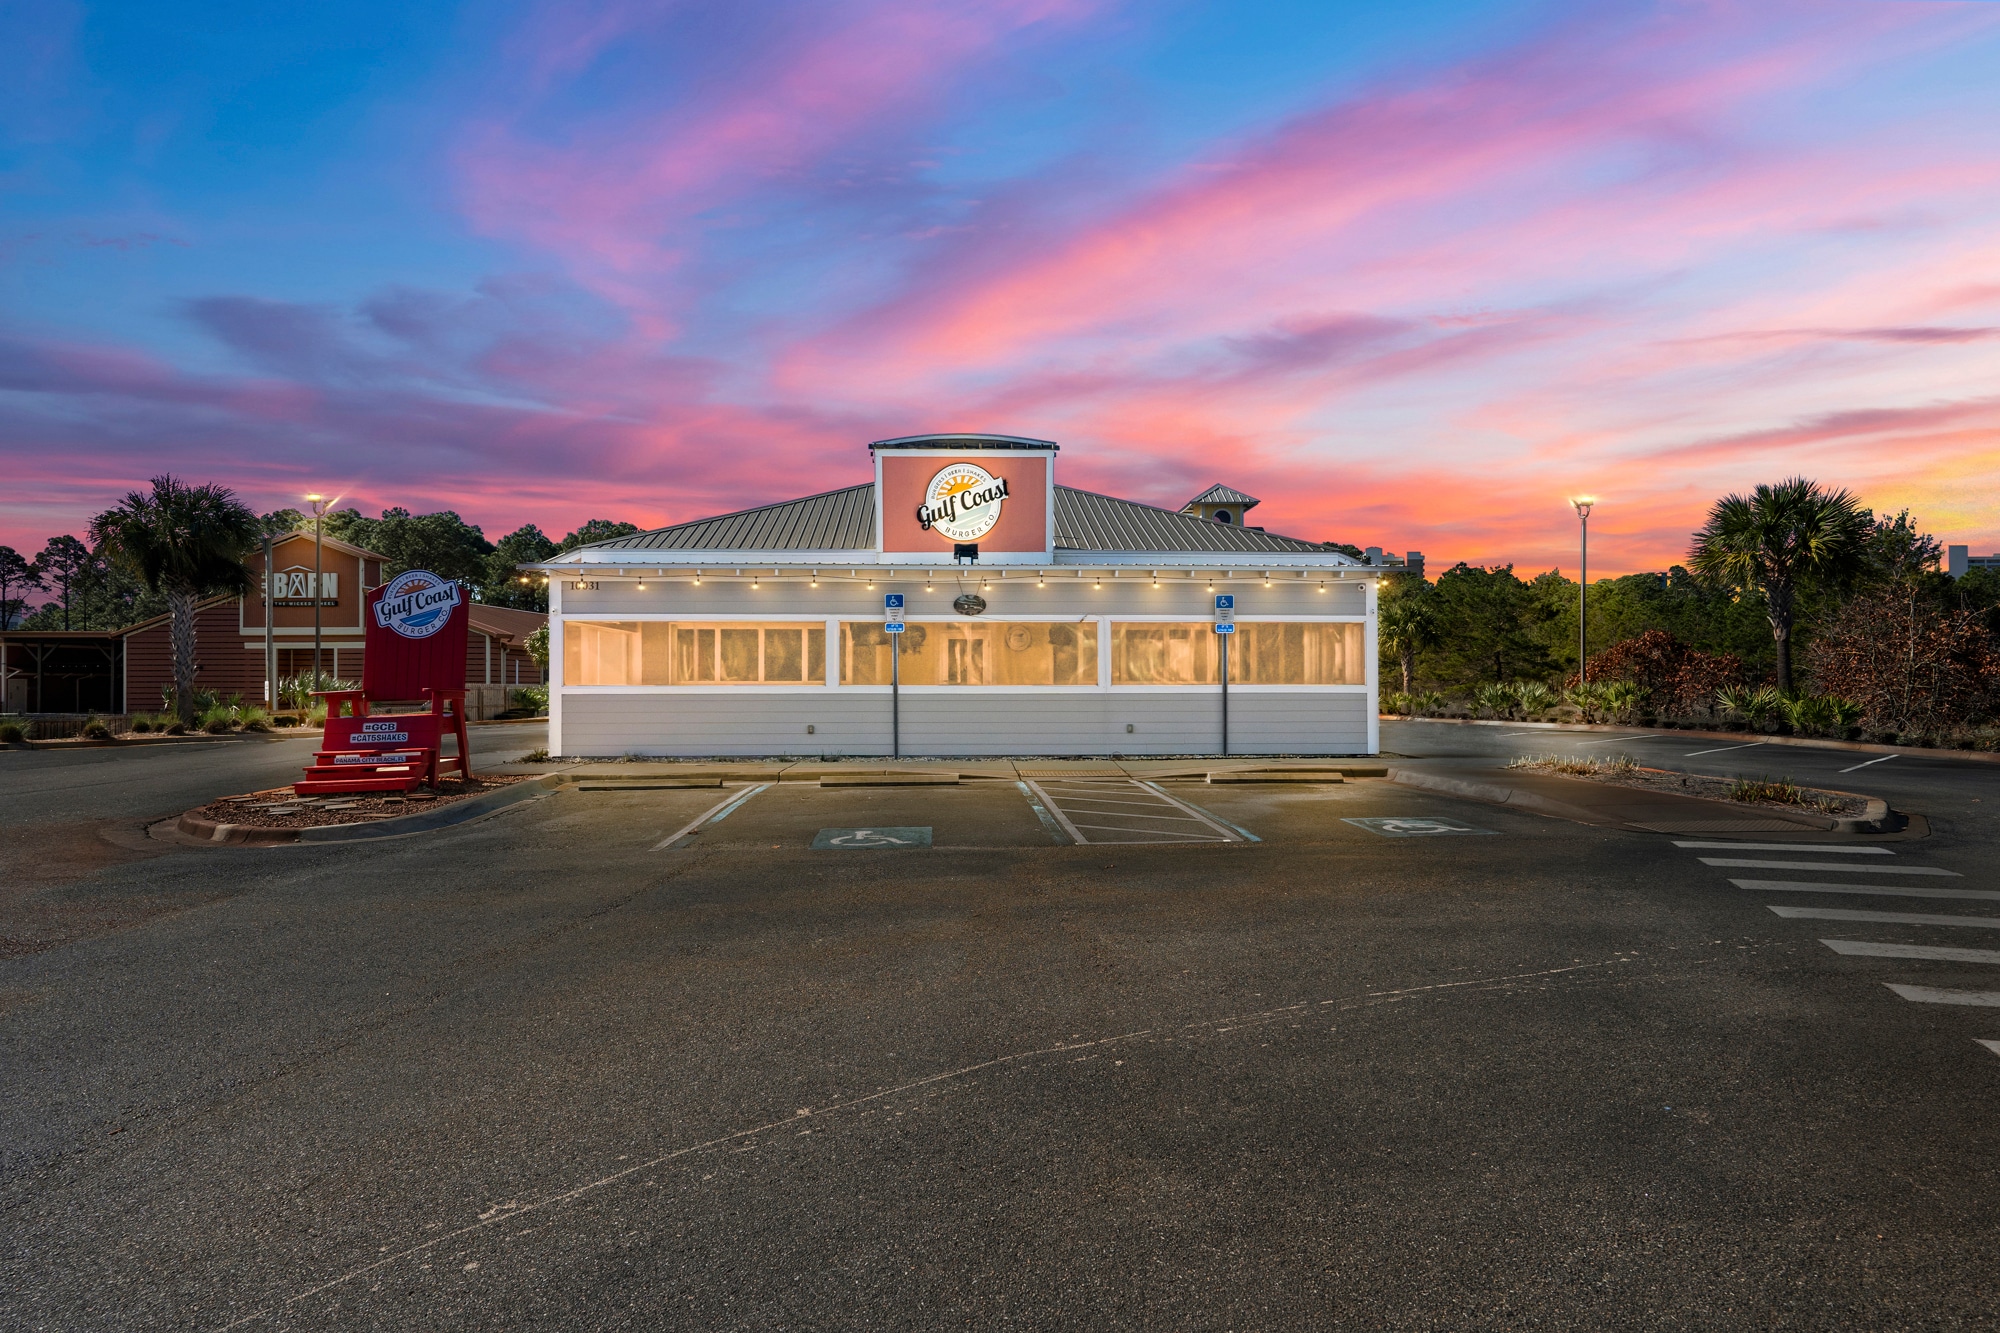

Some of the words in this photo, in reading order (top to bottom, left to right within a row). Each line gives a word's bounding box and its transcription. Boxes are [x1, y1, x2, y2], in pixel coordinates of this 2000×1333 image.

[916, 495, 957, 531] Gulf
[960, 479, 1009, 511] Coast
[944, 526, 983, 538] BURGER
[273, 572, 338, 599] BARN
[387, 580, 403, 600] BURGERS
[380, 595, 414, 622] Gulf
[415, 585, 454, 610] Coast
[397, 622, 437, 635] BURGER
[364, 723, 396, 731] #GCB
[351, 733, 407, 742] #CAT5SHAKES
